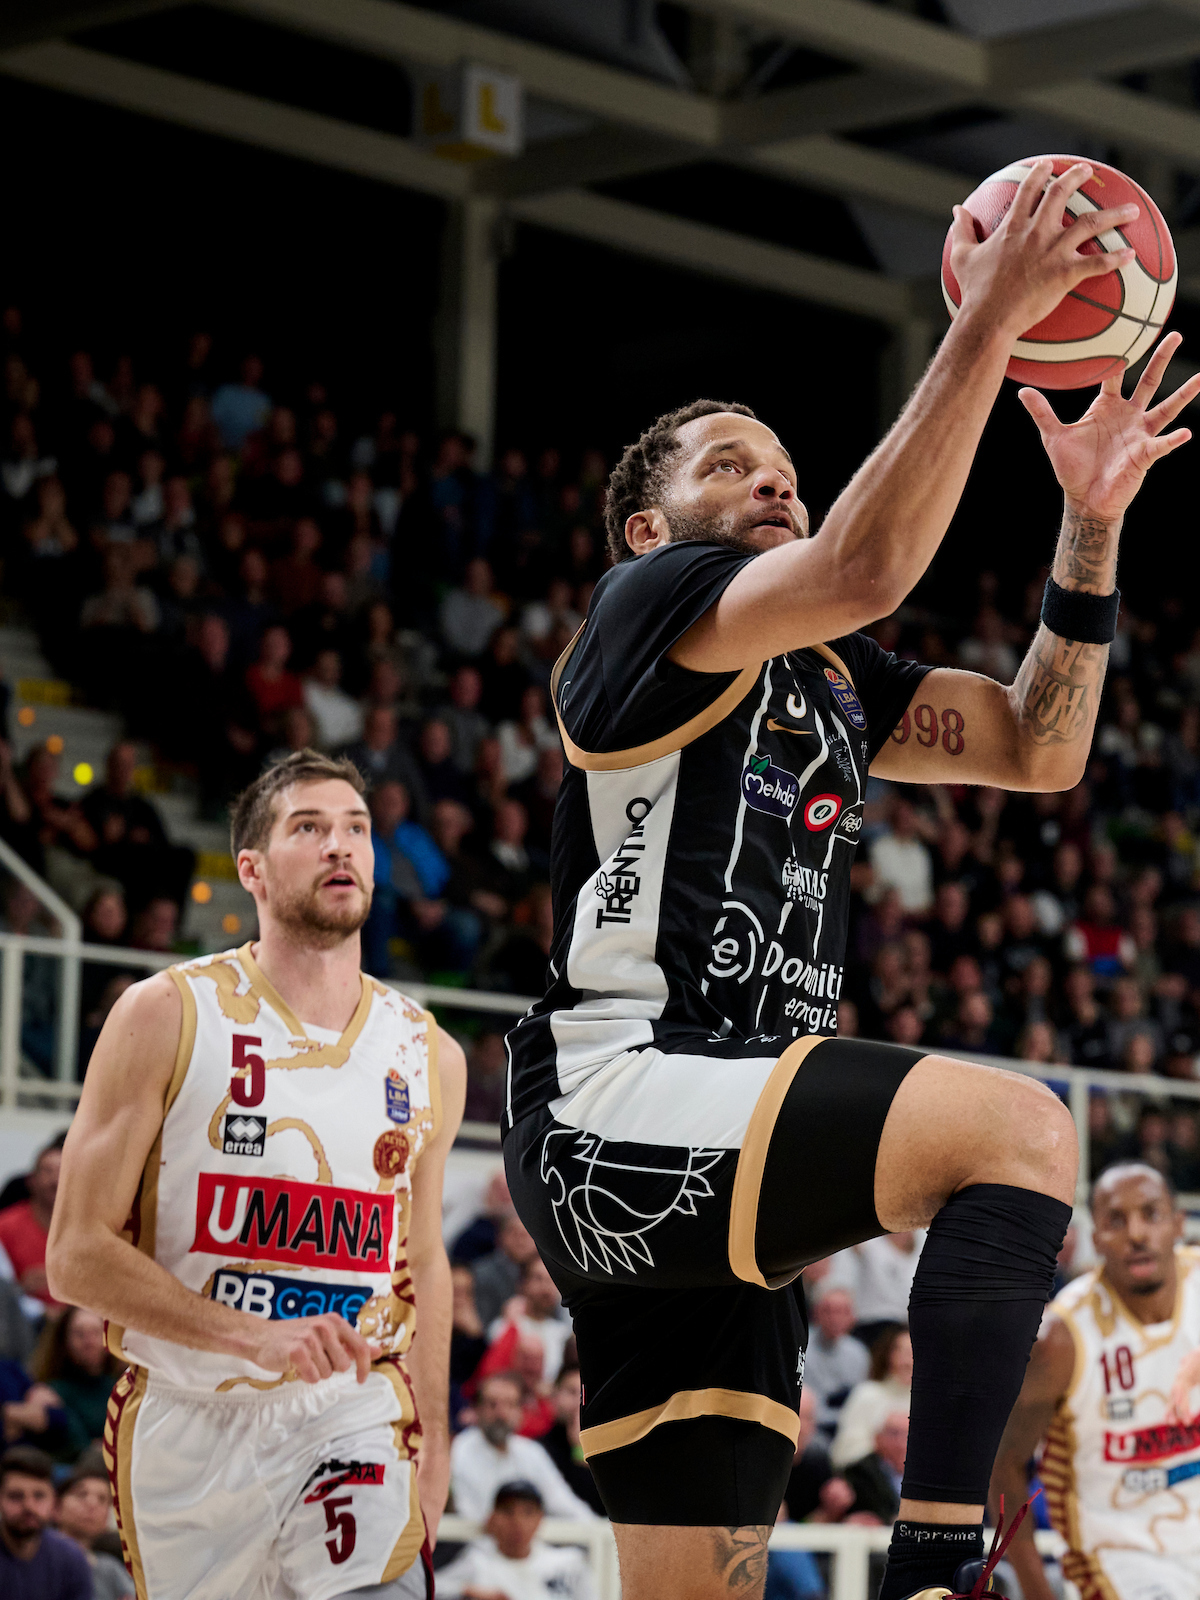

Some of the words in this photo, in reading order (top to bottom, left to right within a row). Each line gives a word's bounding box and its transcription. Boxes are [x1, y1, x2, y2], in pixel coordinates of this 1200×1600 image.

[478, 82, 507, 135] L
[838, 692, 857, 704] LBA
[745, 773, 795, 807] Melnda
[785, 998, 838, 1033] enrgia
[231, 1034, 265, 1107] 5
[225, 1140, 262, 1156] errea
[207, 1185, 383, 1262] UMANA
[1100, 1346, 1135, 1394] 10
[322, 1496, 357, 1565] 5
[900, 1524, 977, 1542] Supreme
